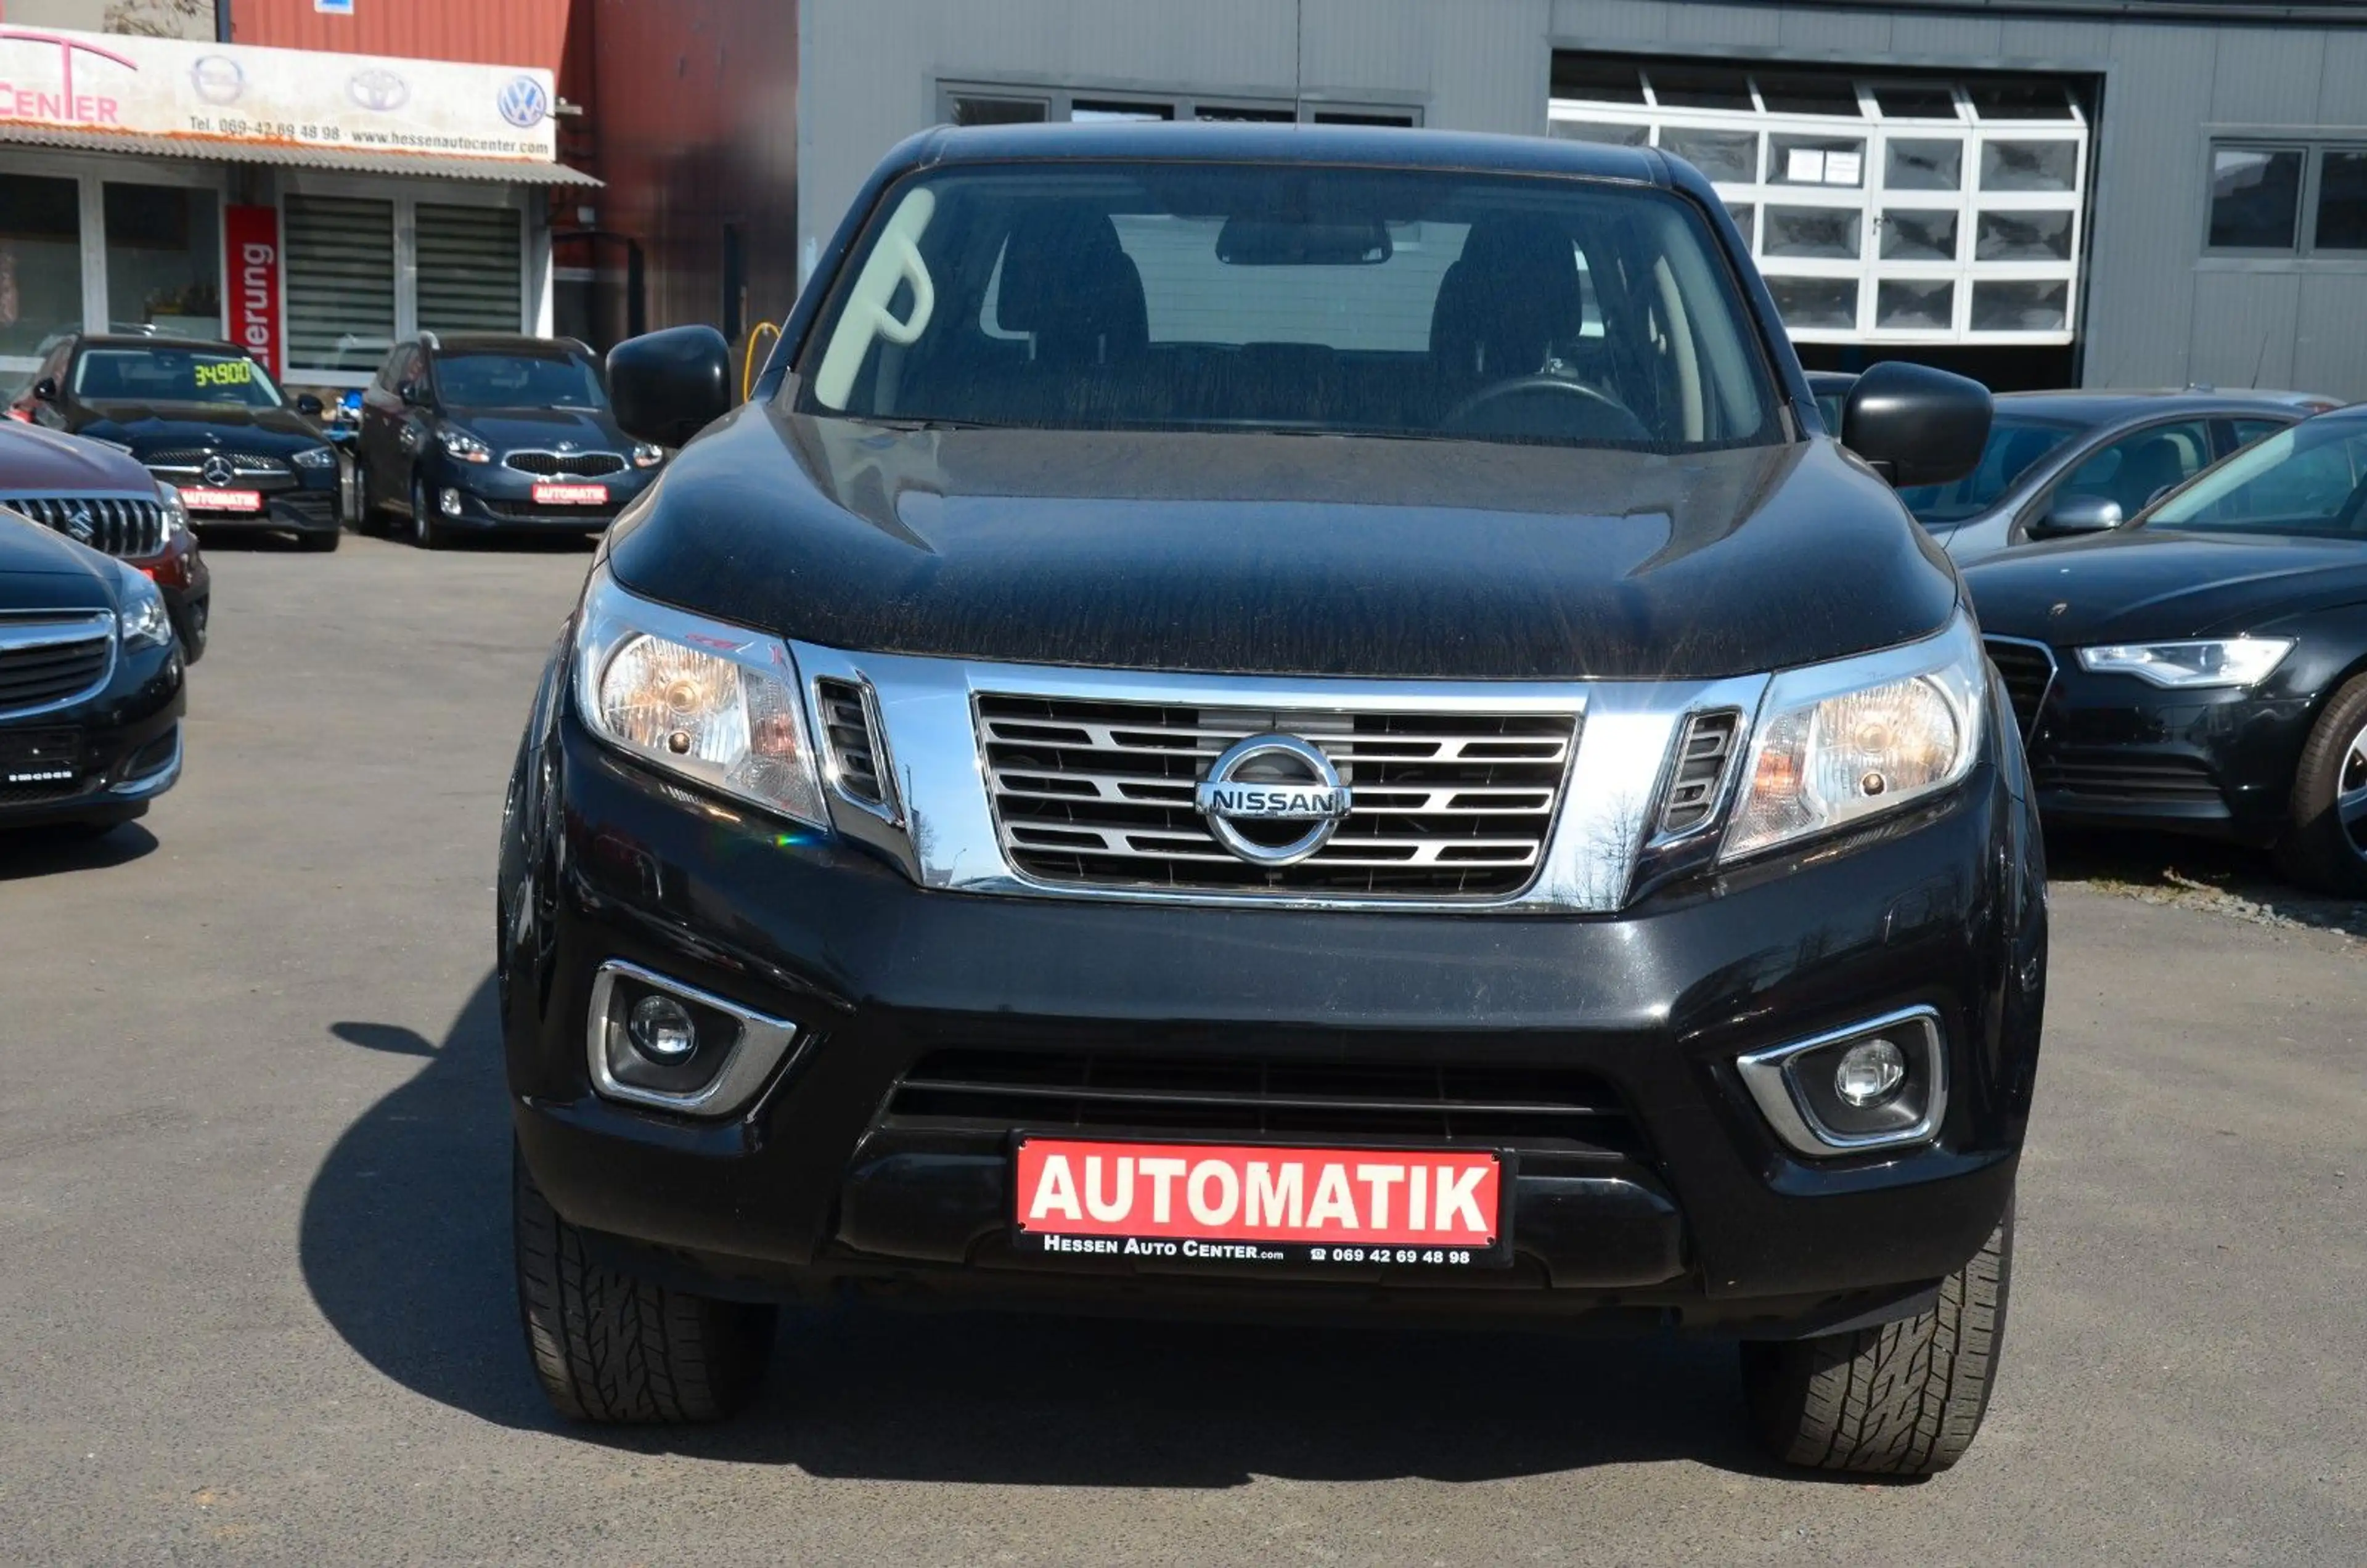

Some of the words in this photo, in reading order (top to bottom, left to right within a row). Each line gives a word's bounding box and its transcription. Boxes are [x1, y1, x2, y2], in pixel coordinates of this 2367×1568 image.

[322, 125, 340, 141] 98
[351, 129, 549, 154] www.hessenautocenter.com
[1212, 789, 1335, 812] NISSAN
[1029, 1154, 1490, 1231] AUTOMATIK
[1332, 1248, 1364, 1262] 069
[1369, 1249, 1391, 1262] 42
[1396, 1250, 1417, 1263] 69
[1422, 1251, 1444, 1263] 48
[1449, 1251, 1471, 1264] 98
